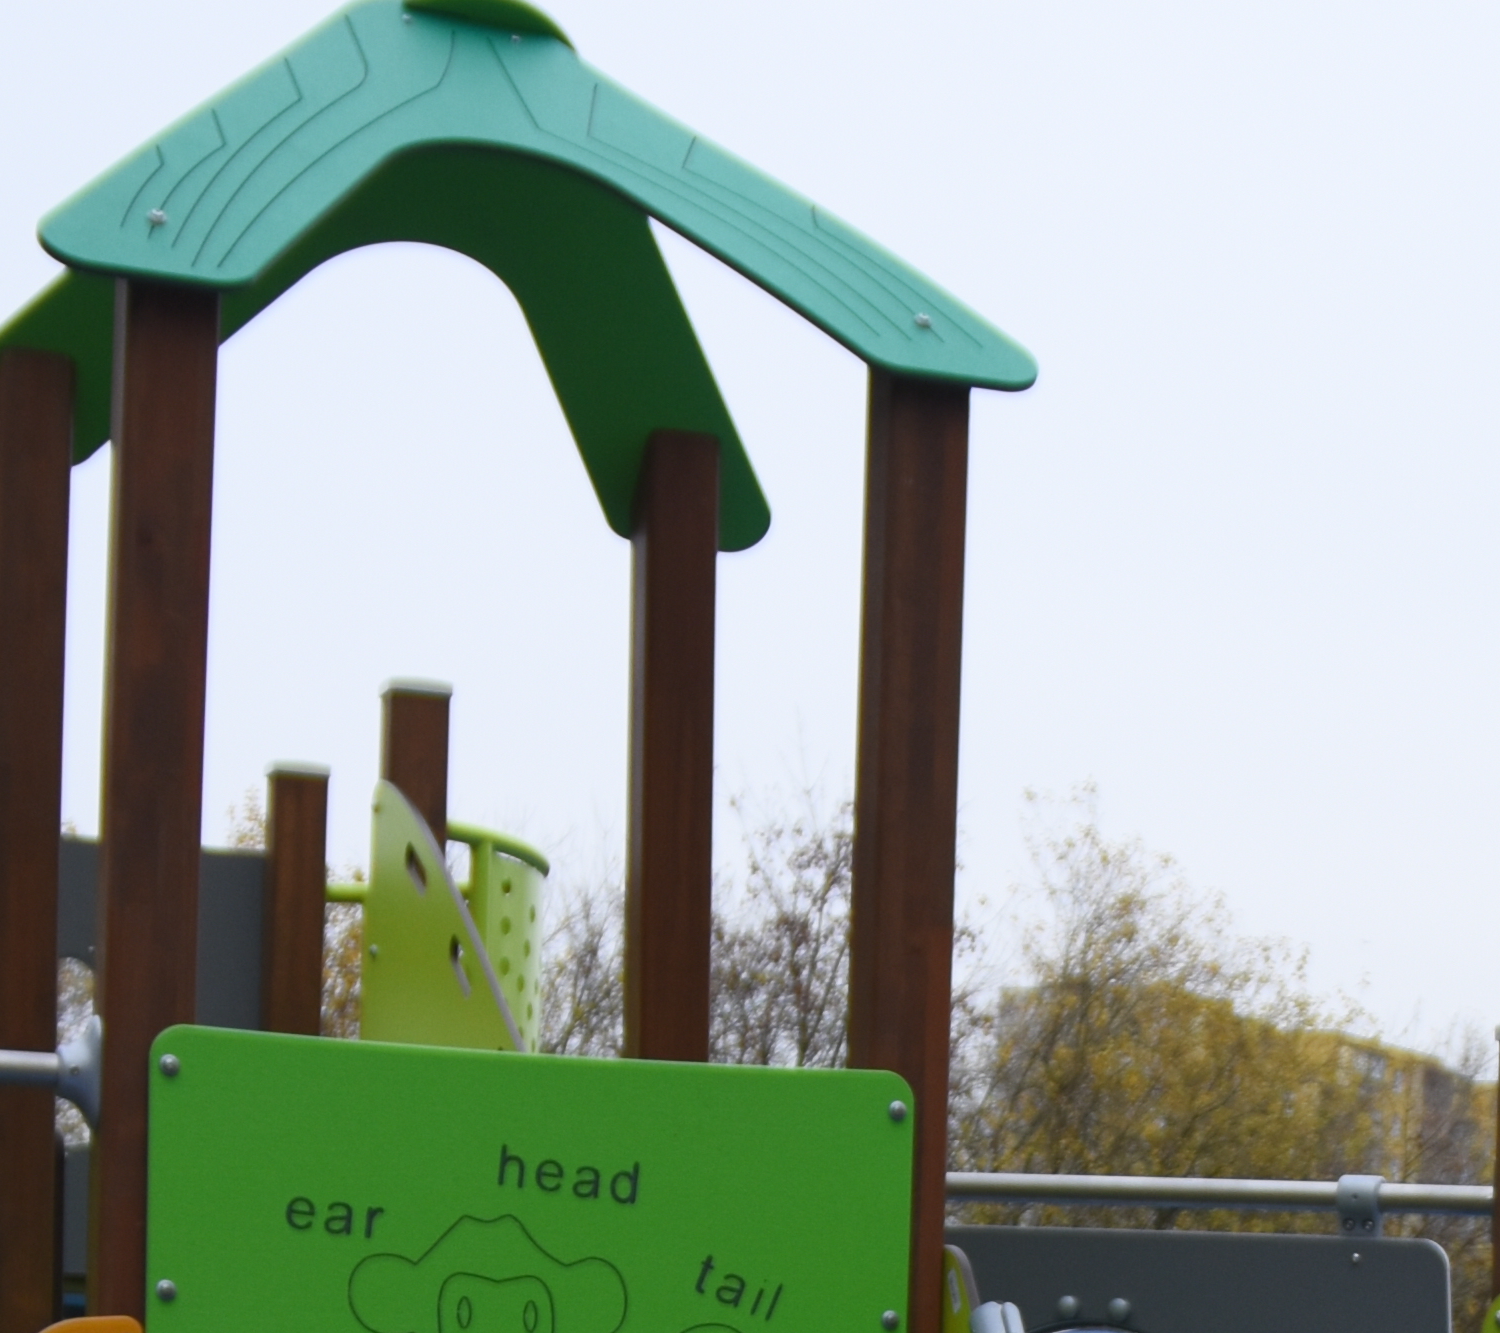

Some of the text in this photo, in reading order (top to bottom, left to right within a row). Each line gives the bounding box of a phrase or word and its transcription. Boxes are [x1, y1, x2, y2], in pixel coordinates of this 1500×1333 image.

[497, 1144, 642, 1205] head
[284, 1195, 385, 1240] ear
[694, 1254, 784, 1322] tail
